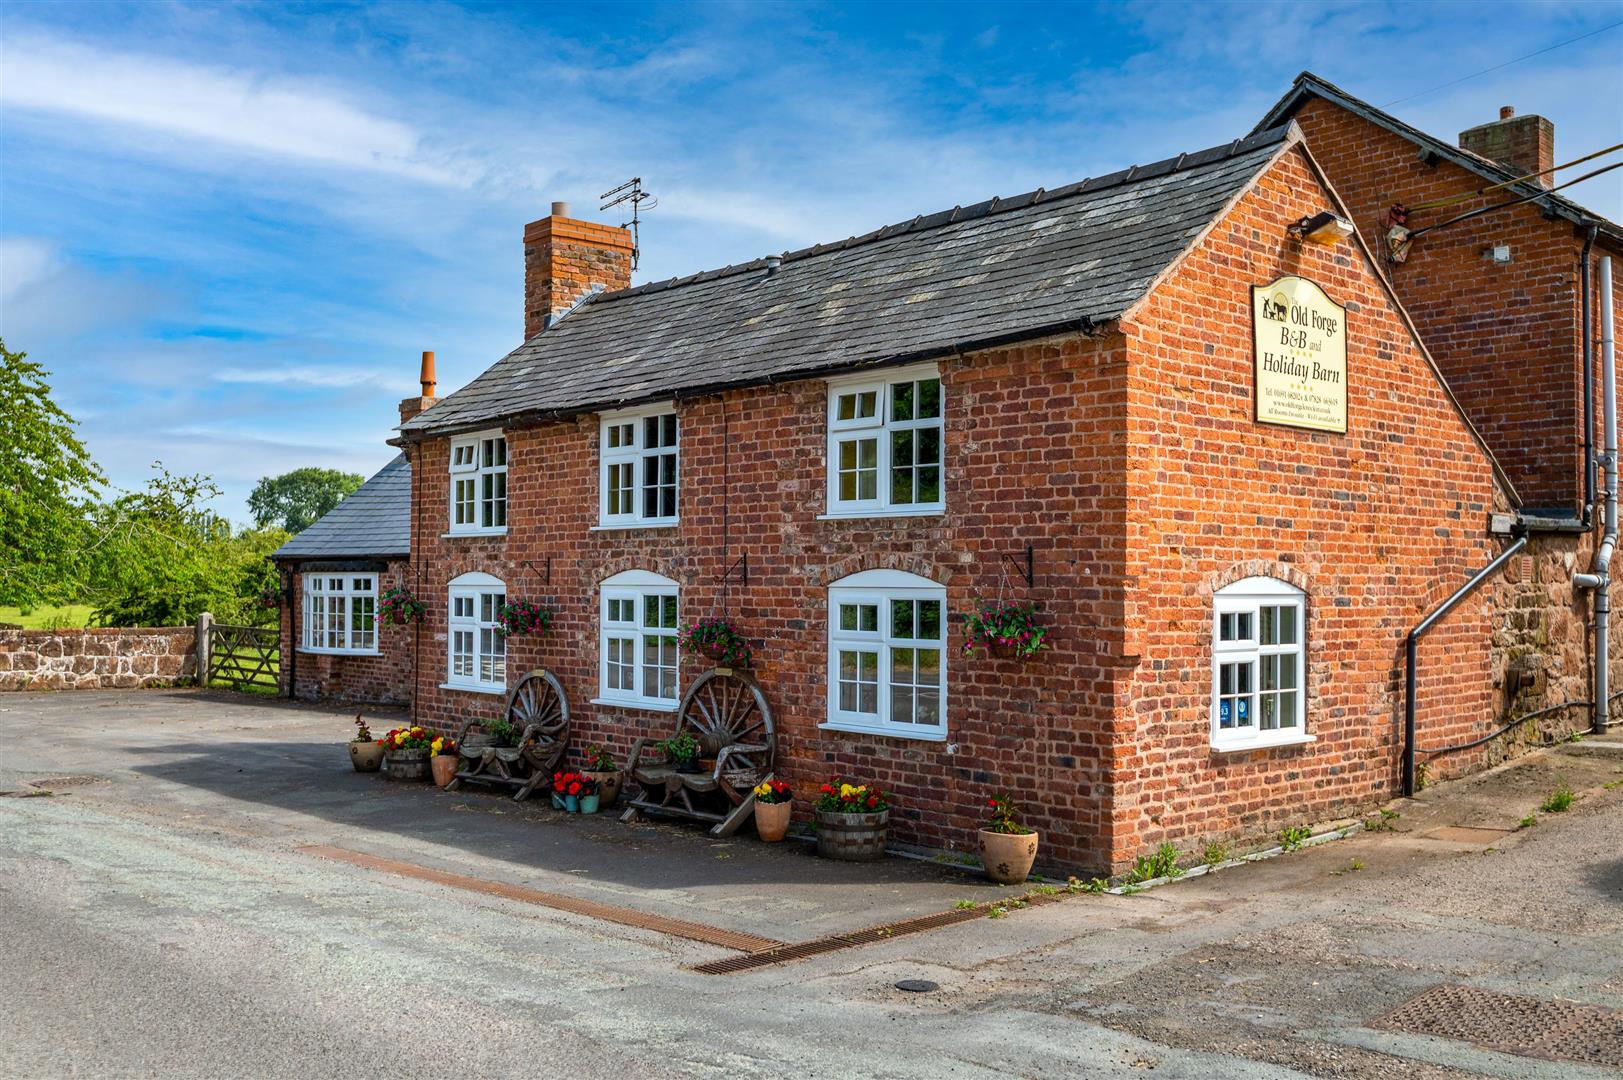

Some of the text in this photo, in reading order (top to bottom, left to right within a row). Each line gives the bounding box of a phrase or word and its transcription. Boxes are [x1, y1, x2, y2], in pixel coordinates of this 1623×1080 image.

[1291, 305, 1338, 337] Old Forge
[1280, 326, 1322, 352] B&B and
[1263, 352, 1340, 384] Holiday Barn
